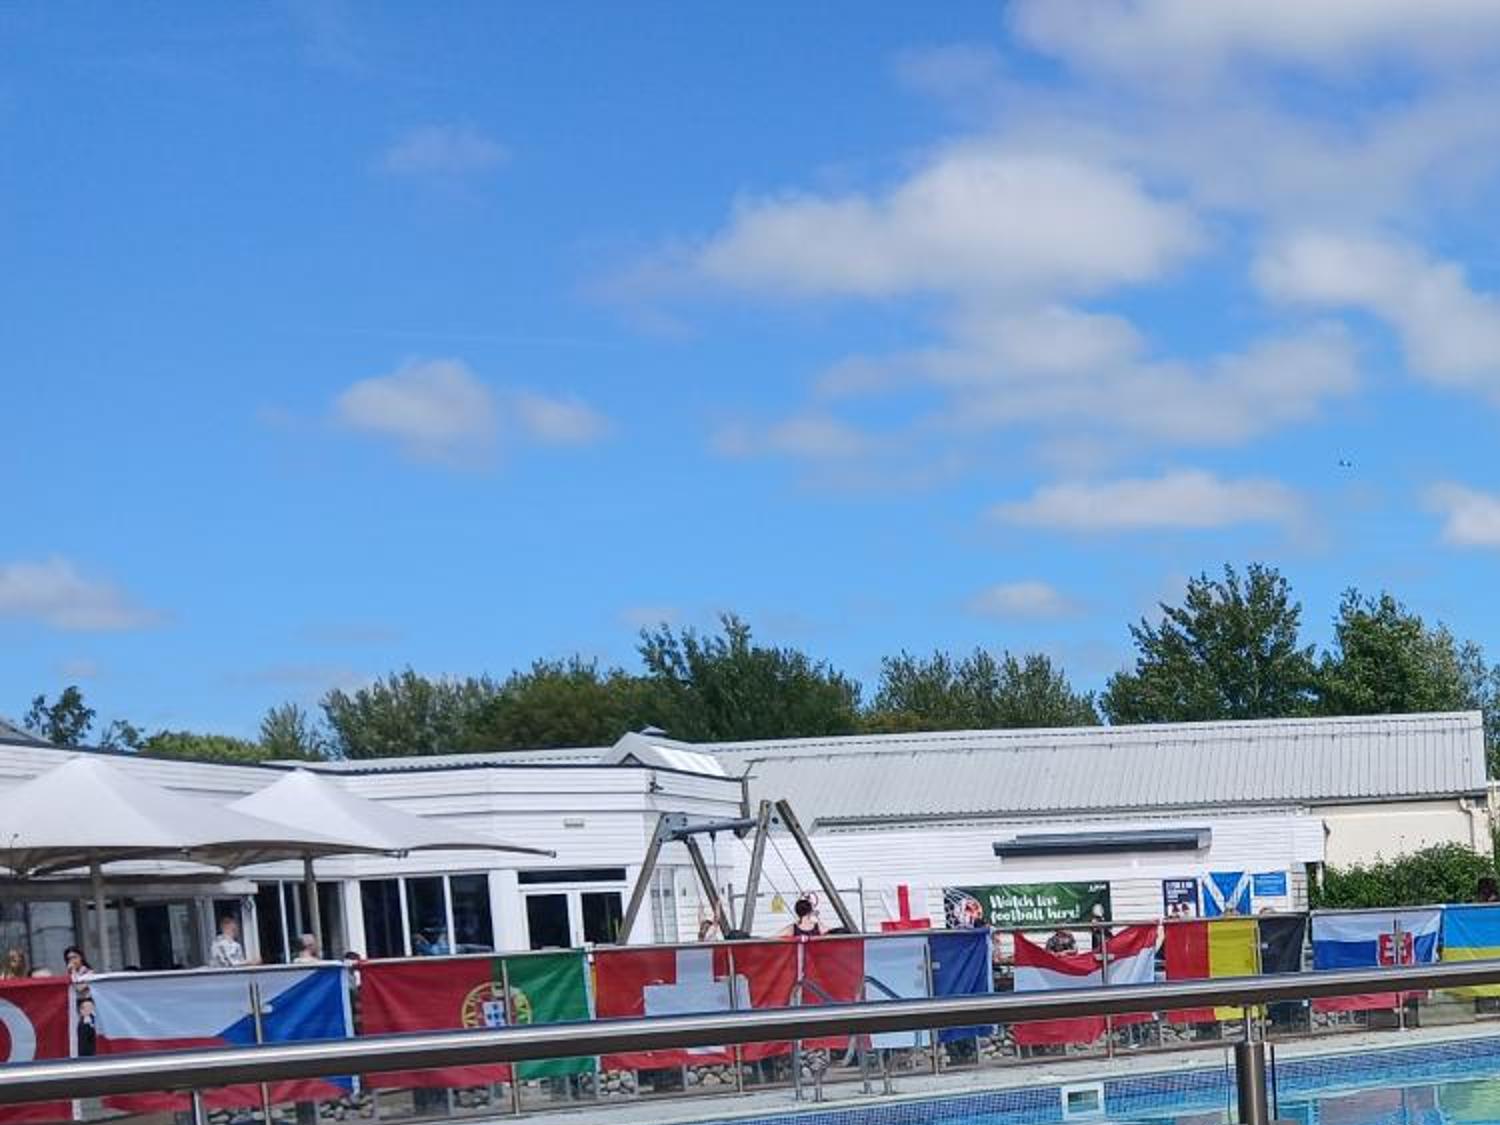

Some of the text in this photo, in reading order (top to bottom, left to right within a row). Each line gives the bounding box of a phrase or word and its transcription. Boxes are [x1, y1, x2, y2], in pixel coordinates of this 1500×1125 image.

[989, 894, 1059, 909] Watch live
[991, 906, 1045, 924] football
